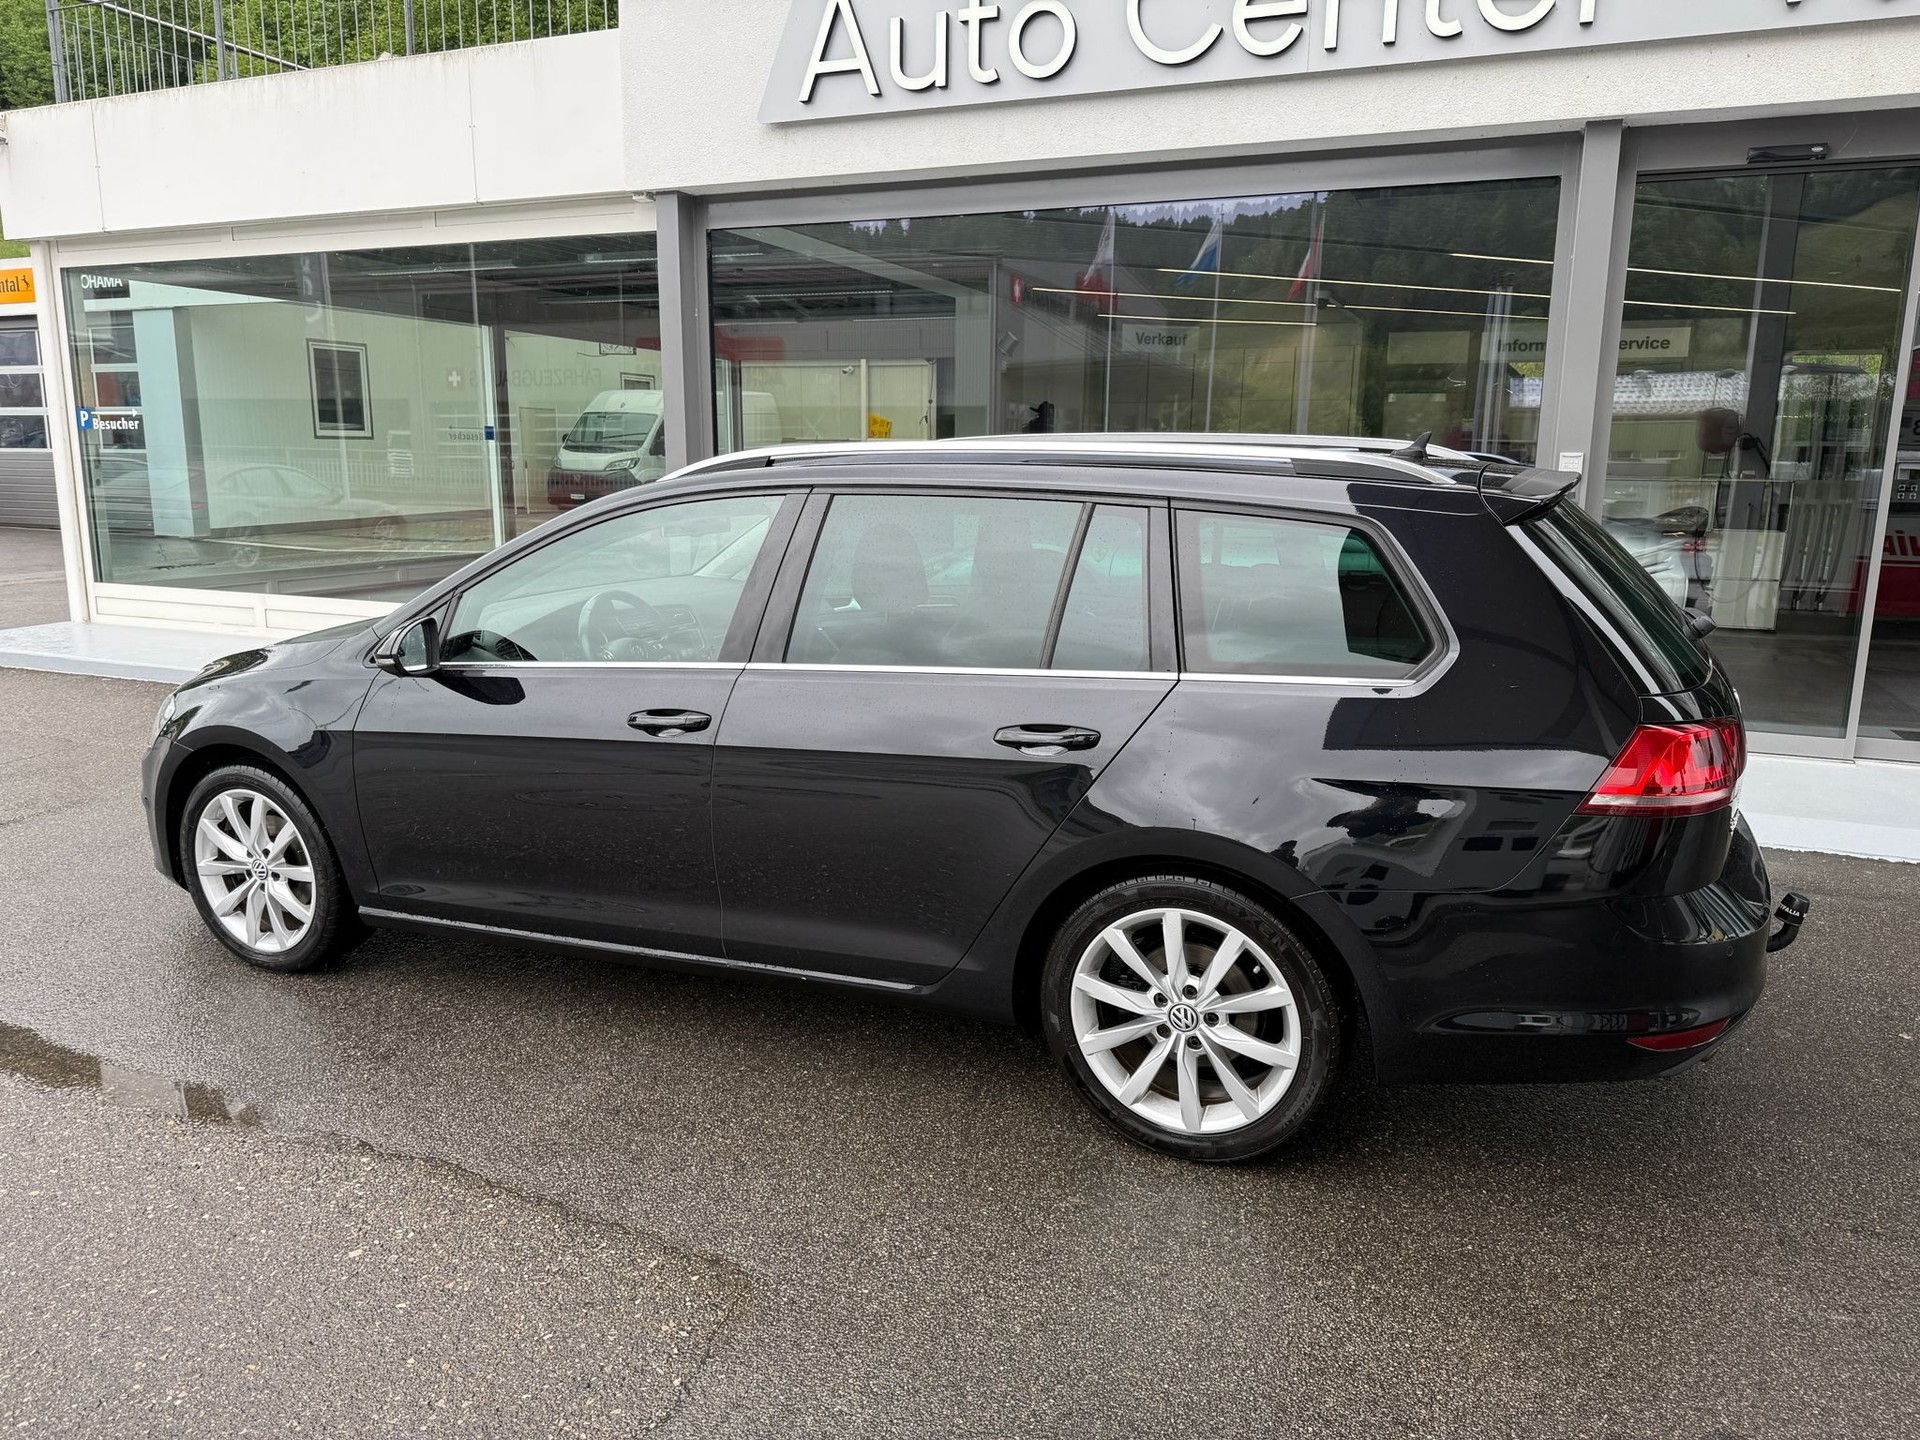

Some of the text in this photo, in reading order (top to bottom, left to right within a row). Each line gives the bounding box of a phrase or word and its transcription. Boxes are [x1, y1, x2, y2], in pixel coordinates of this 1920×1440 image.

[799, 0, 1077, 105] Auto
[1135, 332, 1188, 346] Verkauf
[1619, 336, 1671, 350] ervice
[80, 411, 139, 430] P Besucher
